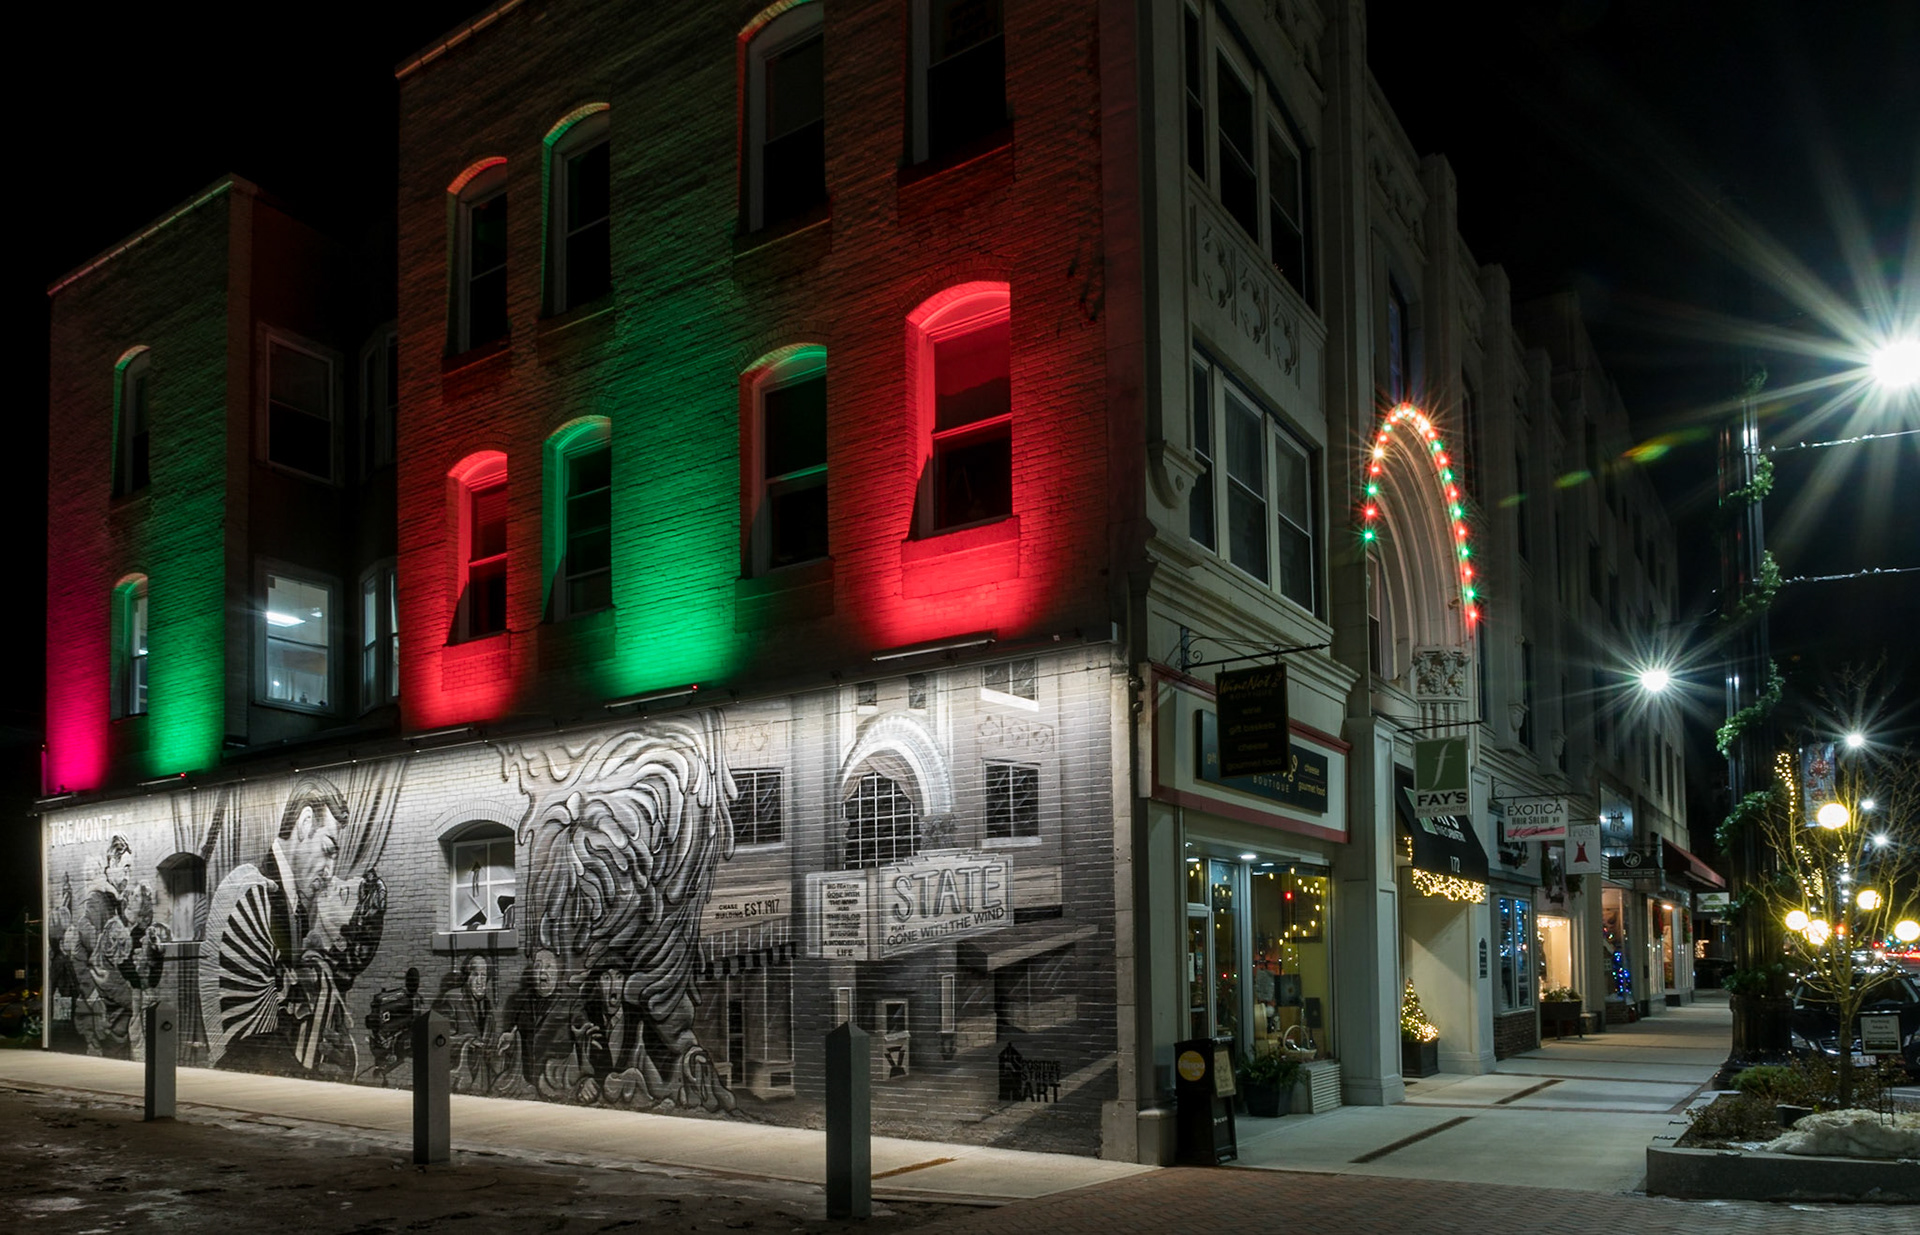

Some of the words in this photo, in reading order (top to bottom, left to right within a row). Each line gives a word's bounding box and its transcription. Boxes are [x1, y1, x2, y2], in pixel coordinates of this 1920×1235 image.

[1237, 742, 1269, 752] cheese
[1262, 757, 1282, 766] food
[1253, 775, 1290, 793] BOUTIQUE
[1417, 791, 1468, 807] FAY'S
[1418, 806, 1432, 814] FINE
[1432, 805, 1467, 814] CABINETRY
[1507, 803, 1564, 816] EXOTICA
[1511, 817, 1527, 825] HAIR
[49, 815, 113, 846] TREMONT
[1449, 855, 1461, 874] 172
[894, 865, 1002, 922] STATE
[715, 911, 743, 919] BUILDING
[887, 930, 919, 945] GONE
[920, 924, 949, 938] WITH
[949, 915, 971, 930] THE
[973, 907, 1004, 924] WIND
[836, 949, 854, 957] LIFE
[1021, 1060, 1061, 1071] POSITIVE
[1021, 1071, 1060, 1082] STREET
[1023, 1081, 1061, 1103] ART
